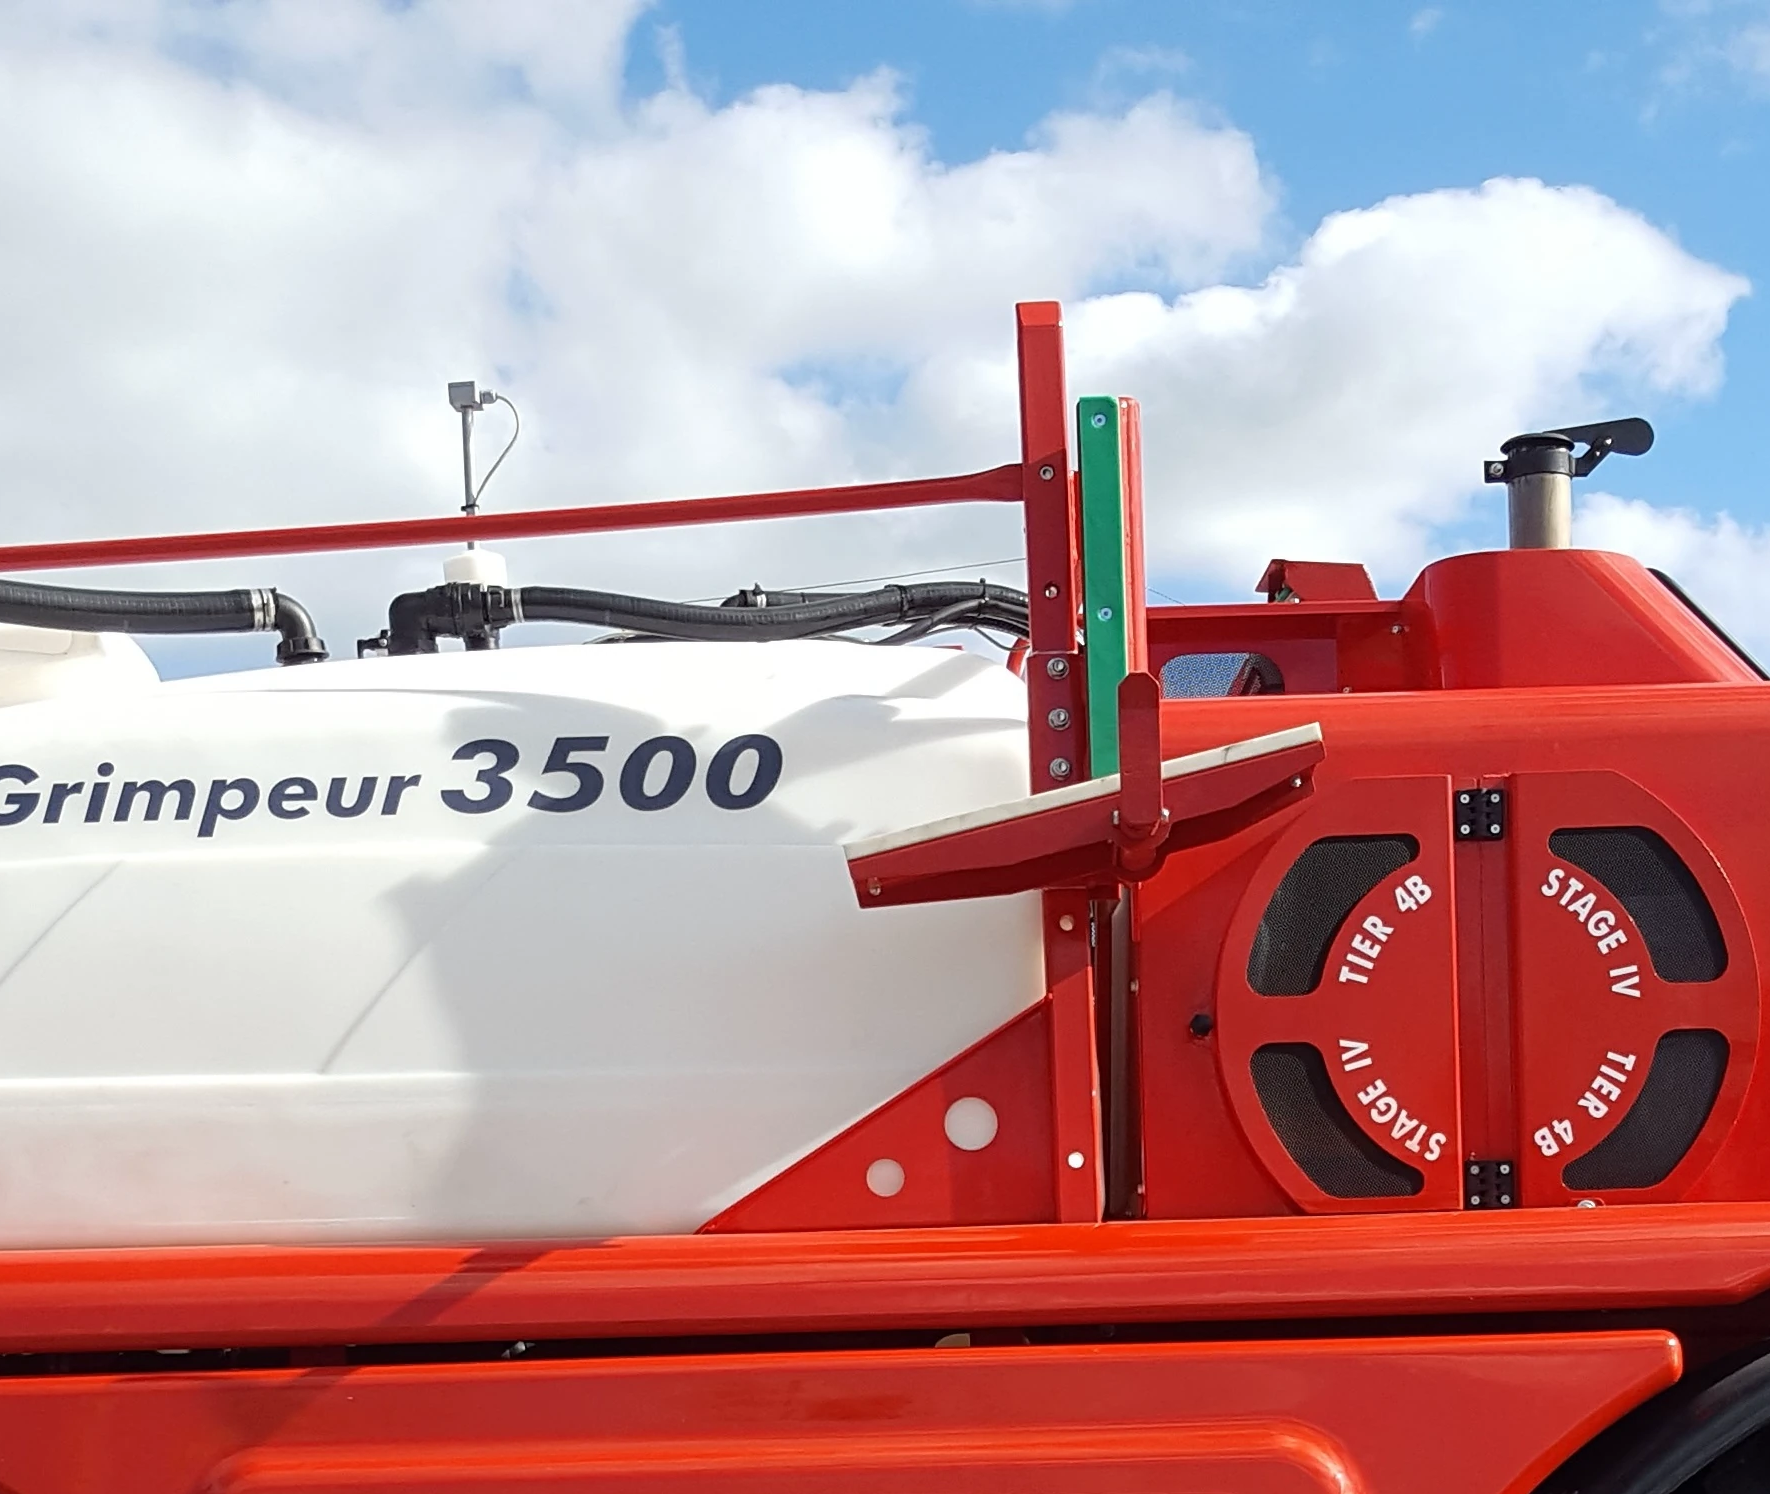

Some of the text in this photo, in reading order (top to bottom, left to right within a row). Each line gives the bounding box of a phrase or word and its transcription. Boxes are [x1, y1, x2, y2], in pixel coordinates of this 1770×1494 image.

[440, 734, 783, 814] 3500
[1338, 875, 1432, 985] TIER 4B
[1541, 868, 1641, 998] STAGE IV
[1339, 1039, 1447, 1161] STAGE IV
[1533, 1051, 1637, 1157] TIER 4B
